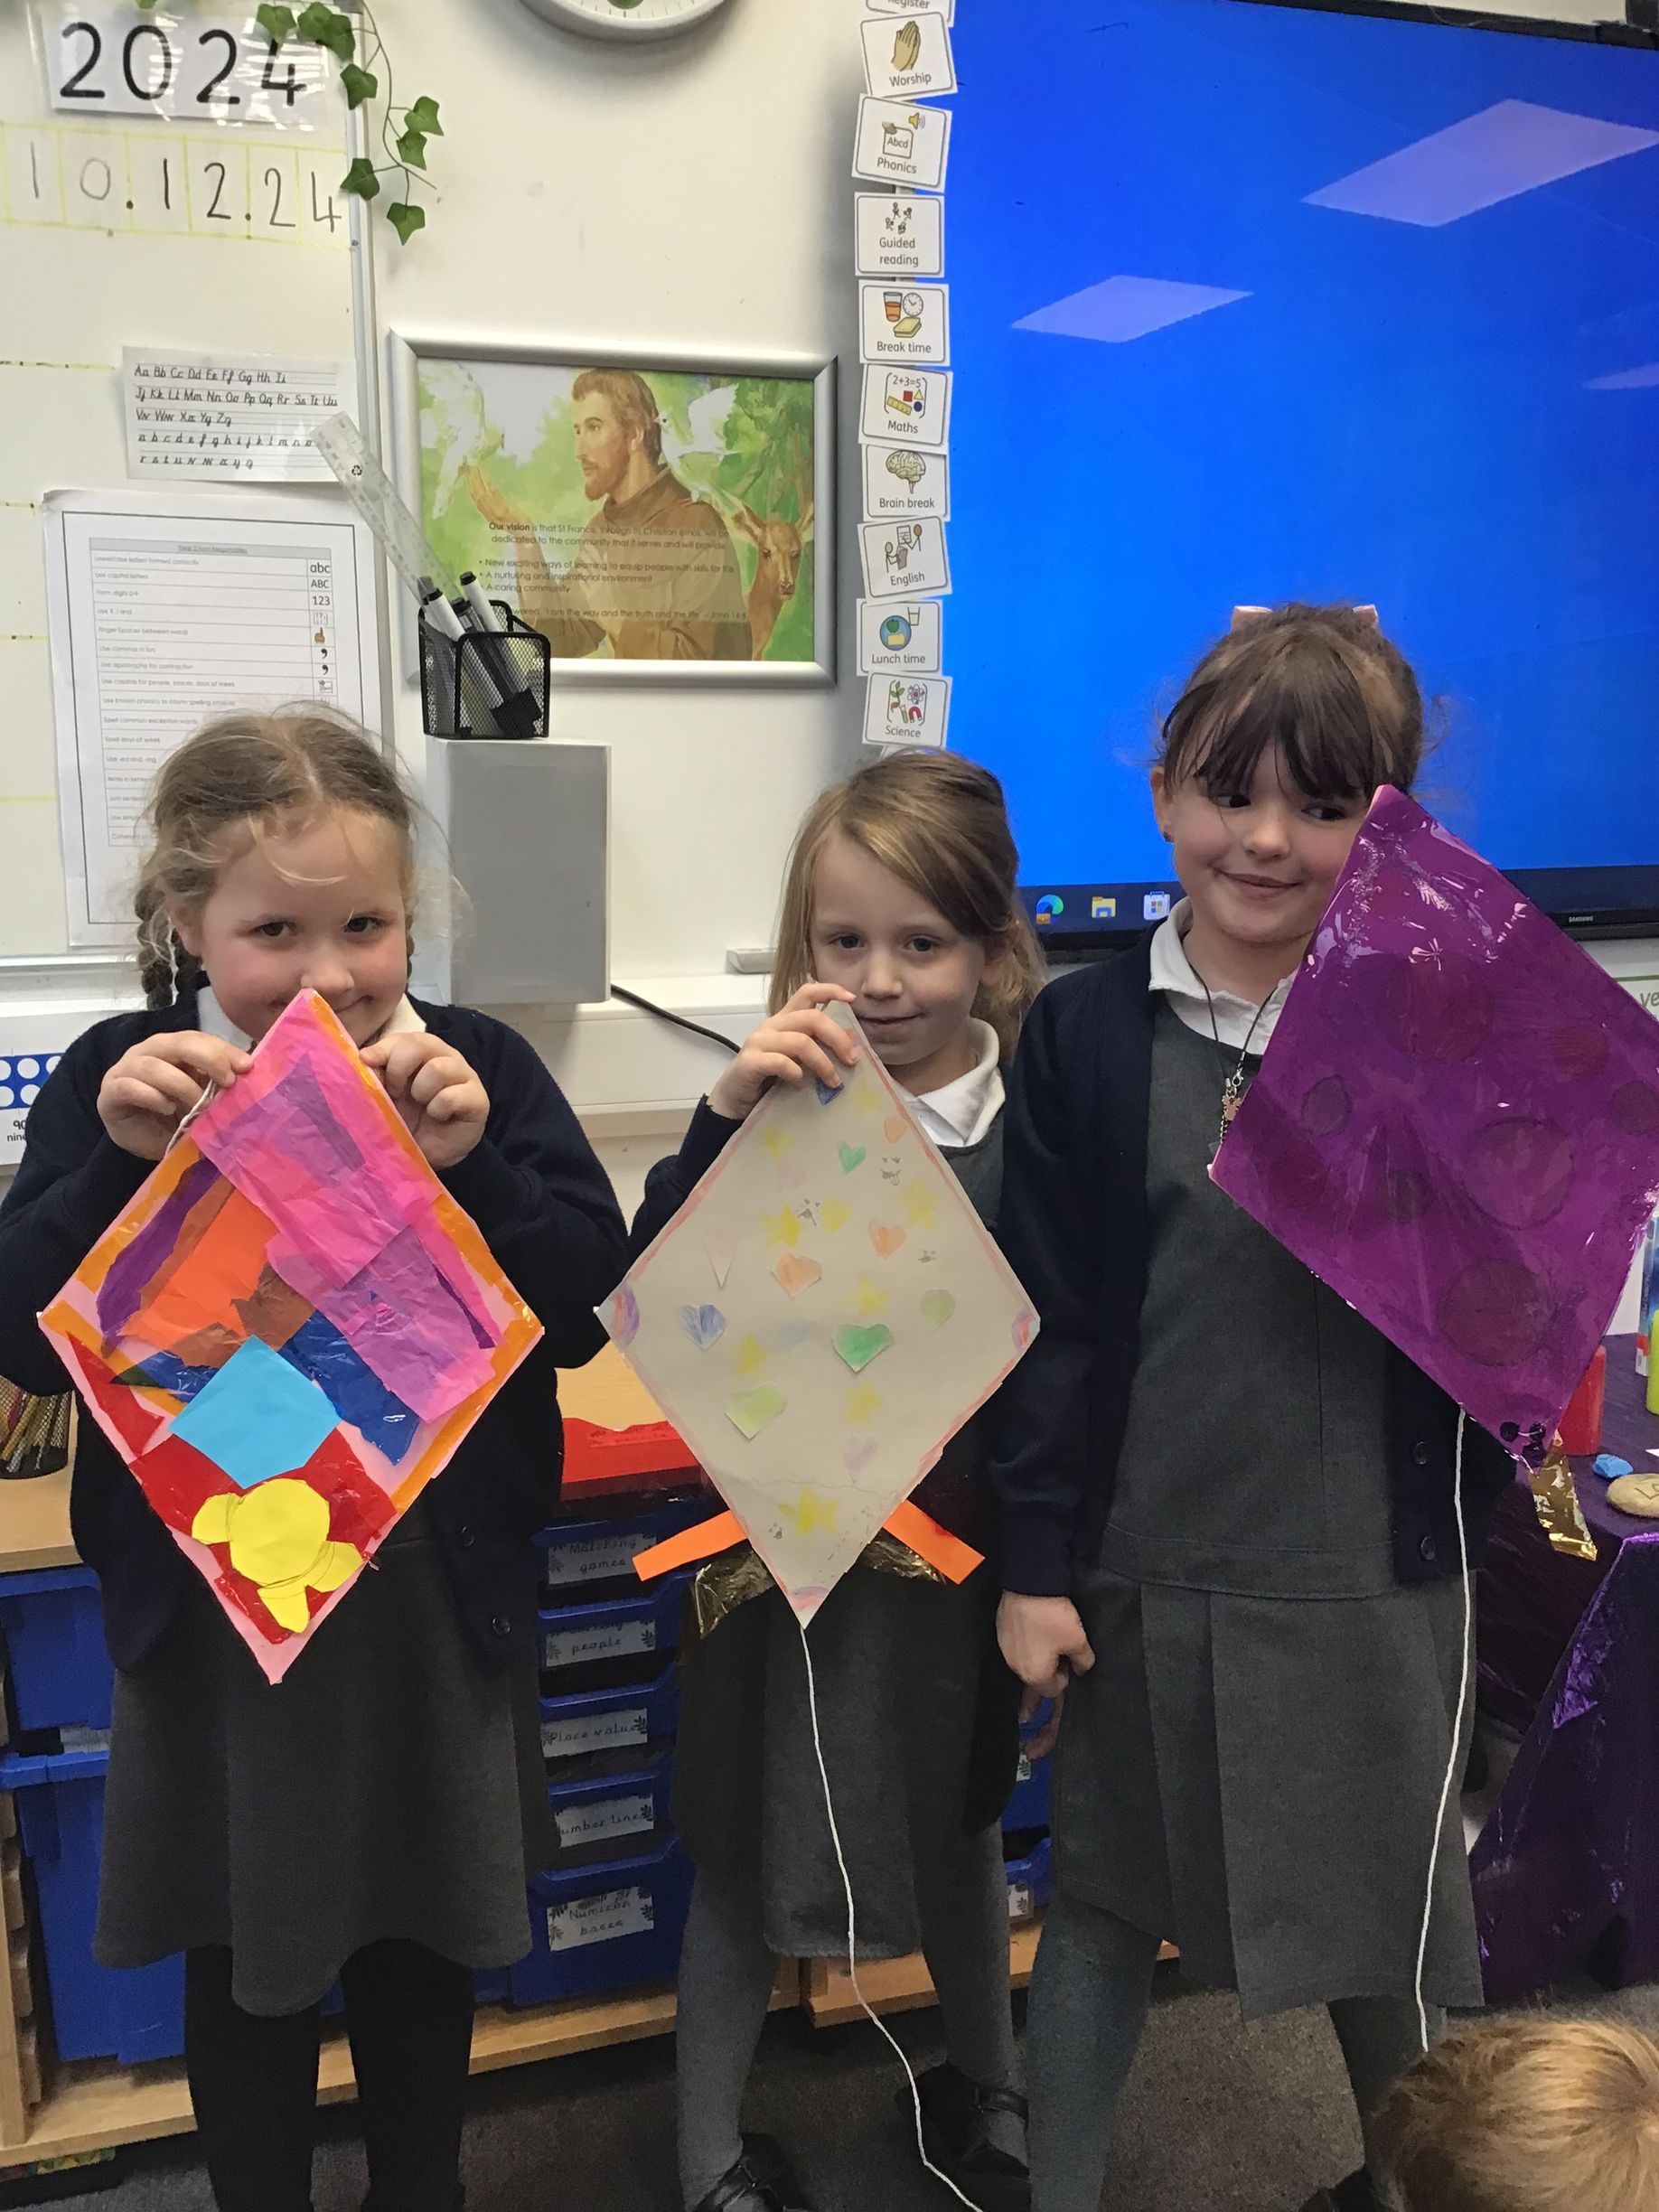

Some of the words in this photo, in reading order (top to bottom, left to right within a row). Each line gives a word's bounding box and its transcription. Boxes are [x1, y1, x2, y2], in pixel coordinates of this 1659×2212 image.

[60, 22, 307, 107] 2024
[889, 72, 932, 87] Worship
[887, 136, 908, 149] Abcd
[876, 157, 917, 174] Phonics
[879, 237, 915, 248] Guided
[879, 254, 919, 267] reading
[876, 341, 905, 351] Break
[908, 342, 932, 353] time
[893, 375, 921, 389] 2+3=5
[887, 420, 919, 434] Maths
[879, 497, 904, 508] Brain
[907, 497, 935, 508] break
[489, 522, 504, 530] Our
[507, 523, 530, 531] vision
[539, 524, 556, 532] that
[491, 535, 537, 543] dedicated
[539, 536, 548, 544] to
[549, 536, 563, 545] the
[564, 538, 610, 547] community
[664, 540, 680, 548] and
[310, 562, 331, 574] abc
[485, 558, 504, 567] New
[311, 578, 330, 589] ABC
[890, 571, 925, 586] English
[494, 584, 521, 593] caring
[313, 595, 331, 606] 123
[871, 653, 901, 664] Lunch
[904, 653, 926, 663] time
[885, 725, 922, 738] Science
[579, 1558, 626, 1575] games
[572, 1636, 622, 1656] people
